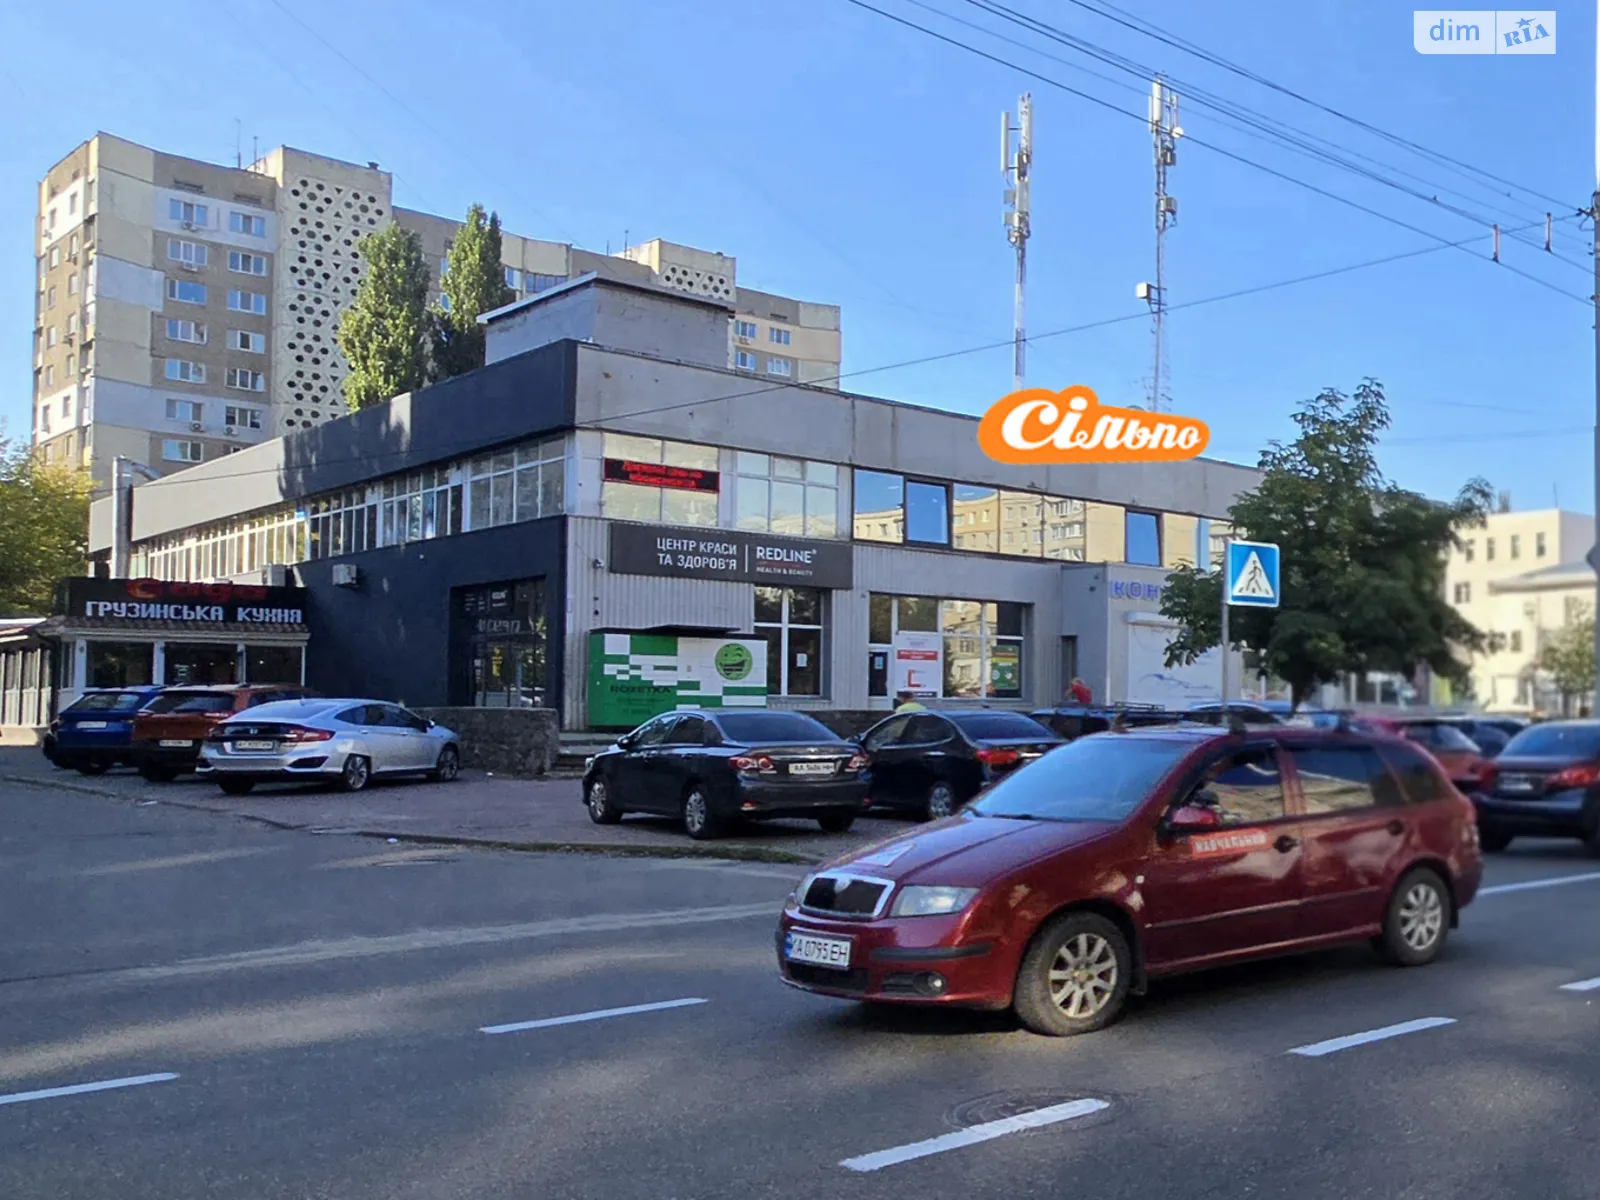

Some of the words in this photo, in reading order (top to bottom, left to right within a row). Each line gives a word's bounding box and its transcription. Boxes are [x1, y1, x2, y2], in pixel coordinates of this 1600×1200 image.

[656, 537, 697, 551] ЦЕНТР
[699, 541, 737, 555] КРАСИ
[657, 553, 673, 566] ТА
[677, 555, 737, 570] ЗДОРОВ'Я
[1112, 580, 1160, 600] КОН
[85, 600, 224, 621] ГРУЗИНСЬКА
[237, 606, 303, 624] КУХНЯ
